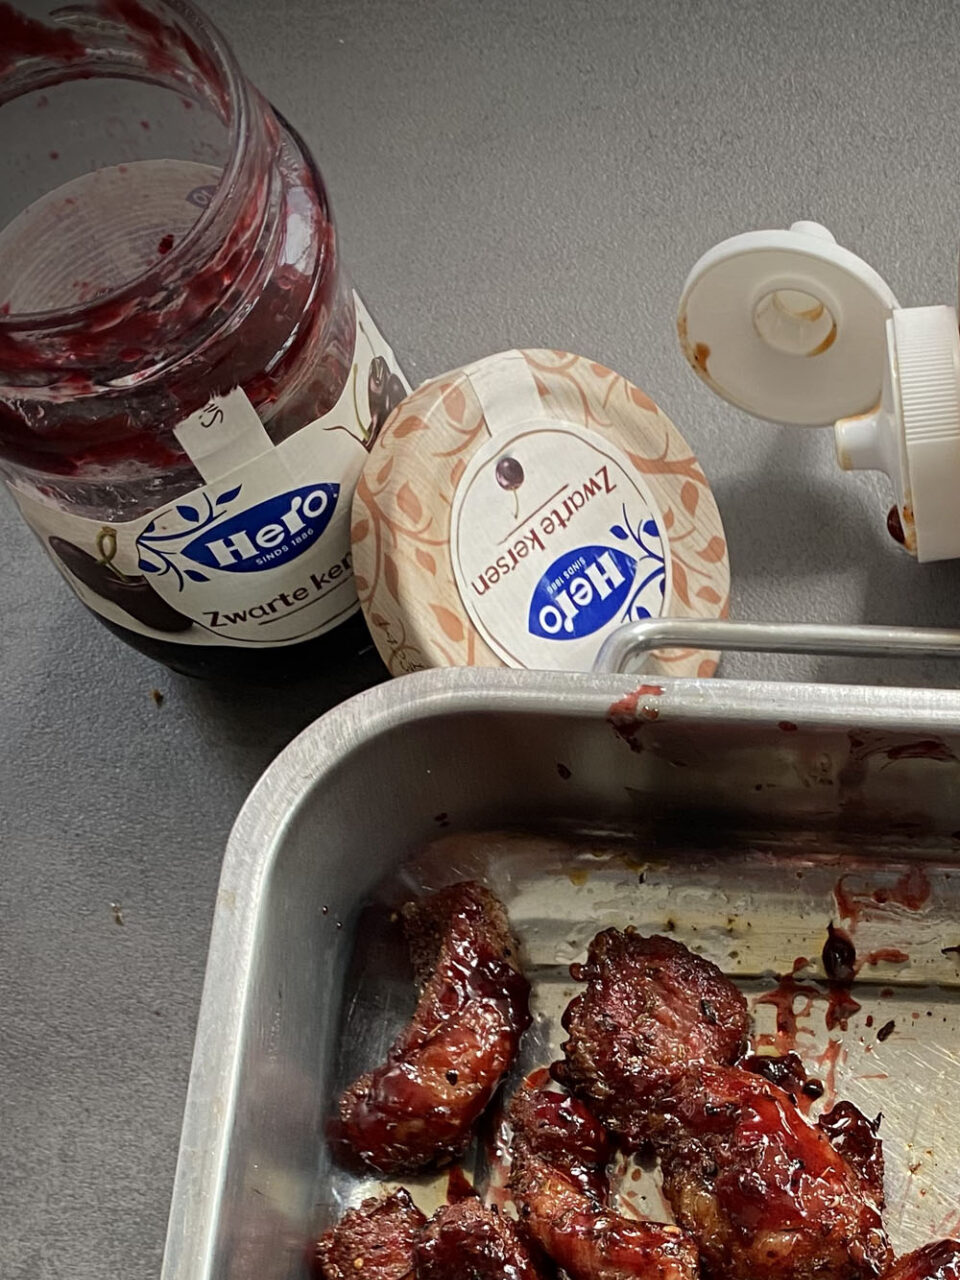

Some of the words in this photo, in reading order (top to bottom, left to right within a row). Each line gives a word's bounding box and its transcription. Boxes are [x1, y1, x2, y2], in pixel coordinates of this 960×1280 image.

[205, 490, 329, 568] Hero
[540, 465, 618, 535] Zwarte
[254, 545, 289, 566] SINDS
[471, 529, 546, 596] kersen
[203, 586, 310, 628] Zwarte
[539, 551, 626, 634] Hero
